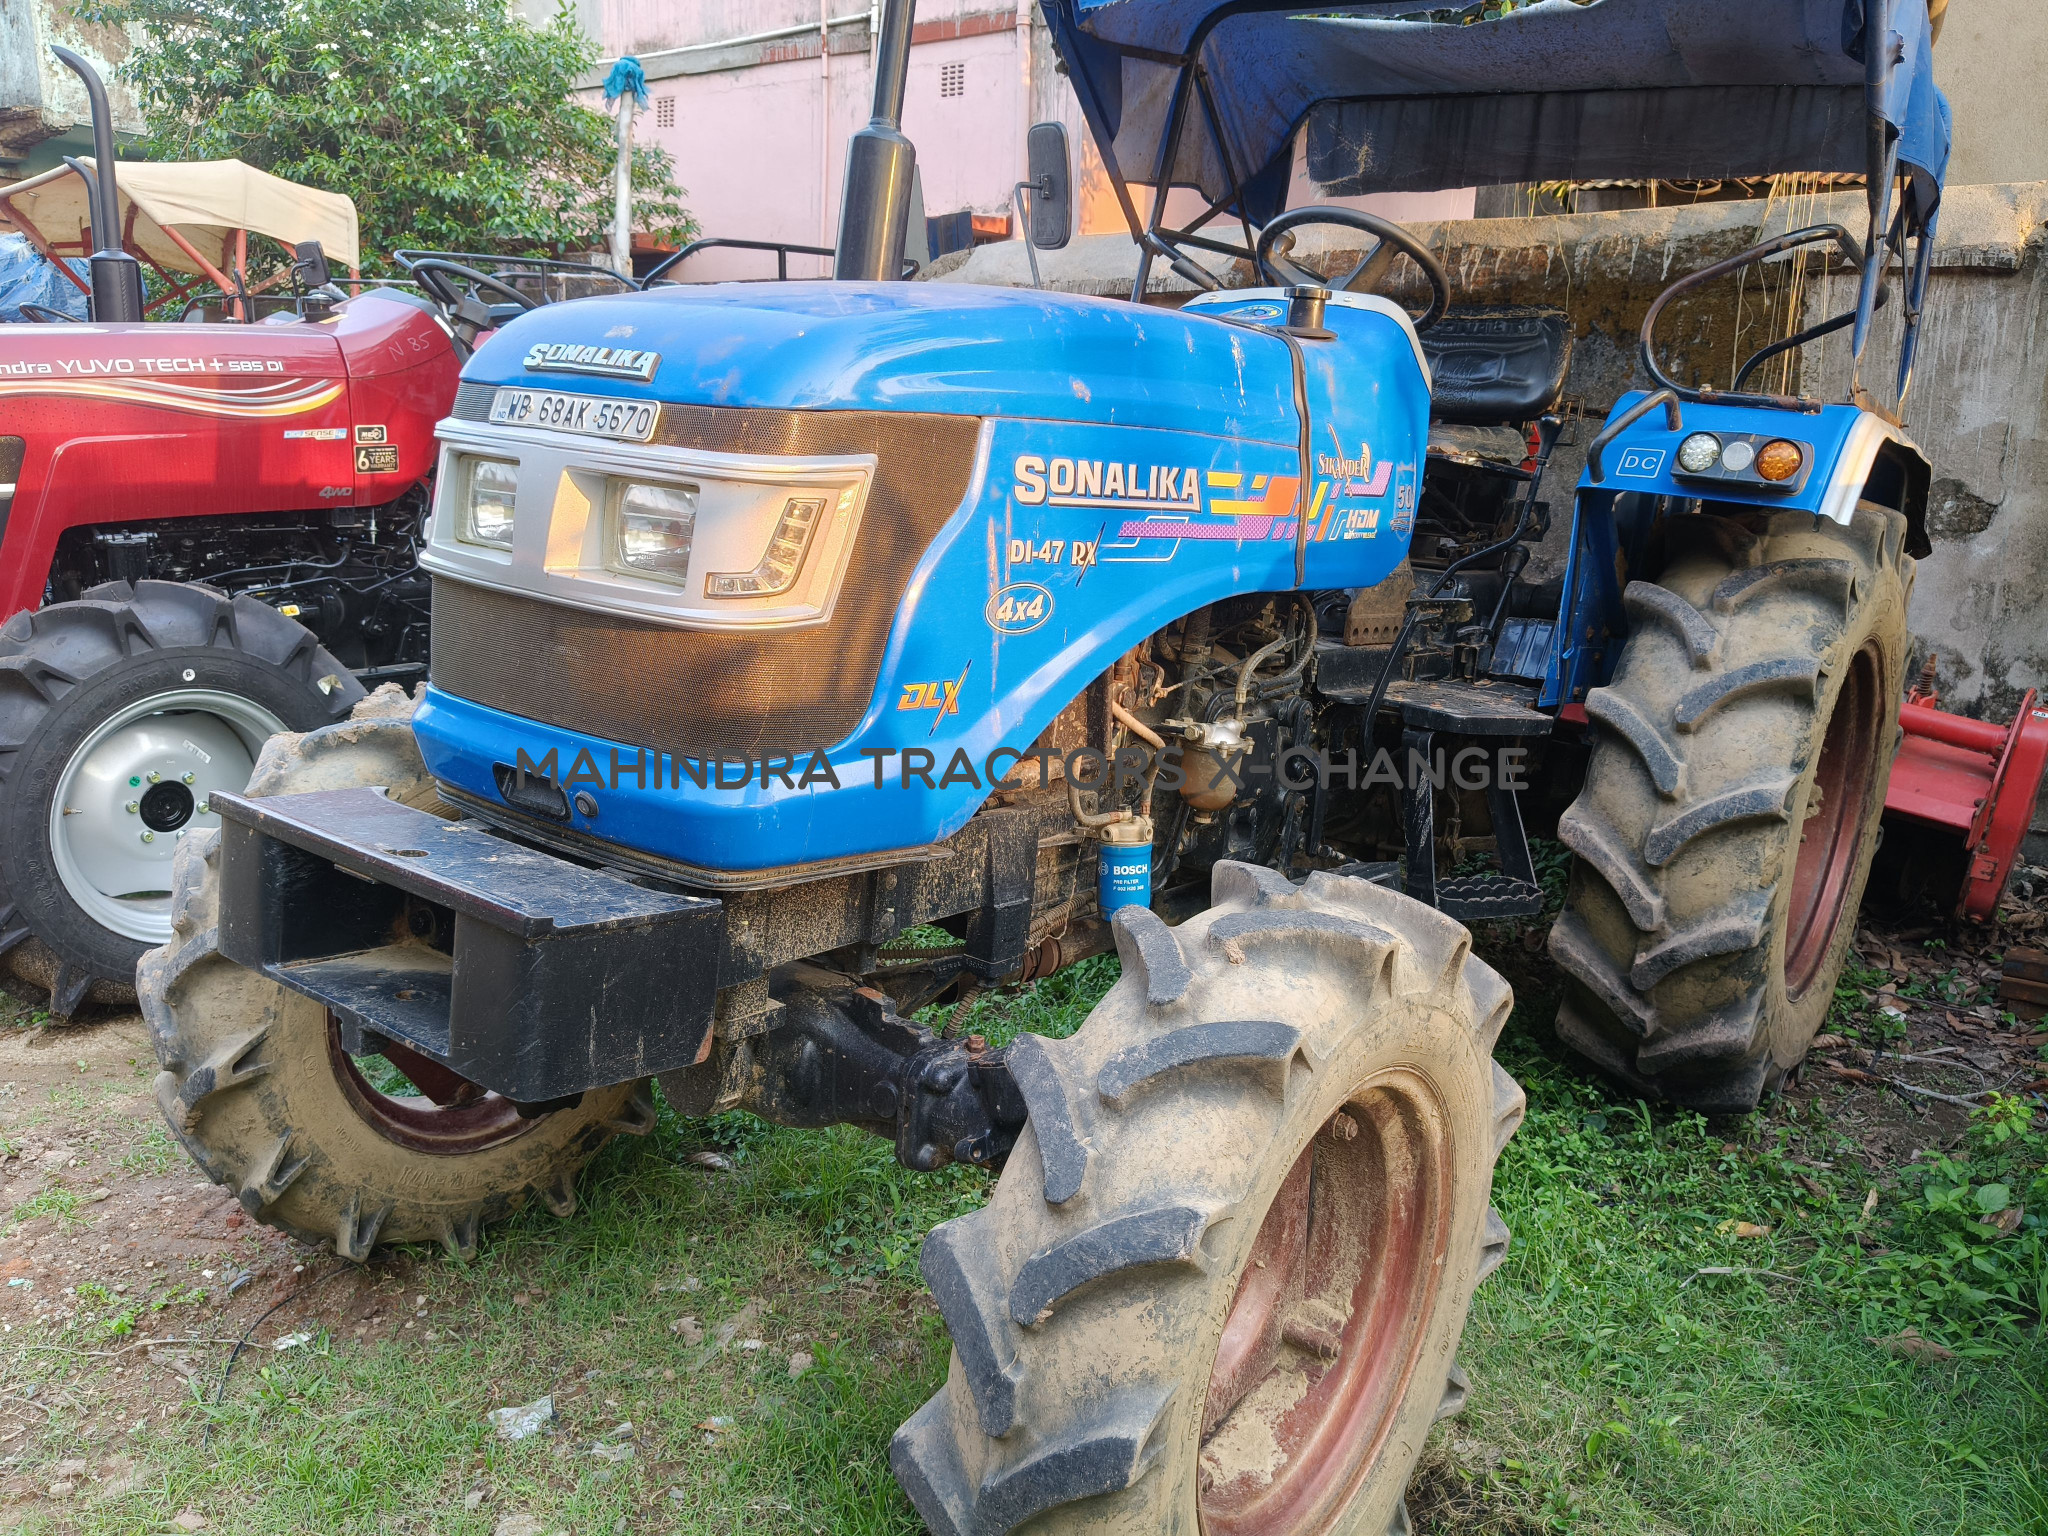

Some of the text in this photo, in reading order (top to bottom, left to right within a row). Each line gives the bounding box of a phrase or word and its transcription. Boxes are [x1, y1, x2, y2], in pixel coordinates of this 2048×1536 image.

[407, 330, 433, 352] 85
[56, 359, 135, 374] YUVO
[228, 360, 264, 372] 585
[266, 360, 284, 372] DI
[523, 343, 661, 381] SONALIKA
[507, 391, 532, 420] WB
[539, 396, 591, 430] 68AK
[597, 402, 651, 434] 5670
[369, 455, 397, 464] YEARS
[1624, 455, 1657, 470] DC
[1014, 455, 1201, 513] SONALIKA
[1346, 509, 1379, 529] HDM
[1010, 540, 1065, 563] DI-47
[1113, 864, 1148, 876] BOSCH
